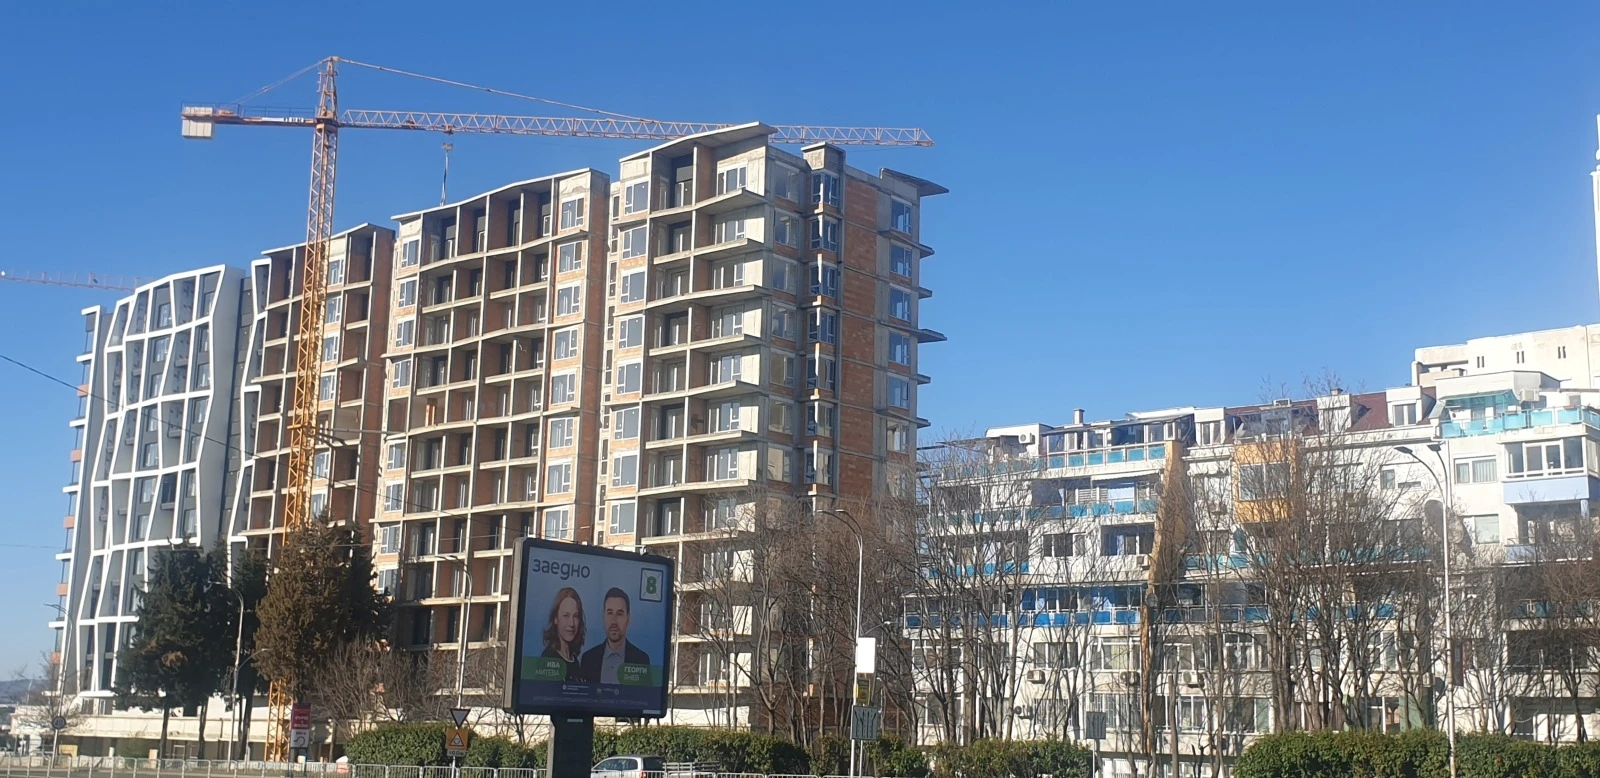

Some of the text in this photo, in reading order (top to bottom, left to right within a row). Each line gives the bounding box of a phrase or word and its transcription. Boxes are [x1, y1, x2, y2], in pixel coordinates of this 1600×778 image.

[532, 558, 590, 580] заедно
[646, 576, 656, 594] 8
[535, 668, 560, 677] МИТЕВА
[624, 665, 648, 674] ГЕОРГИ
